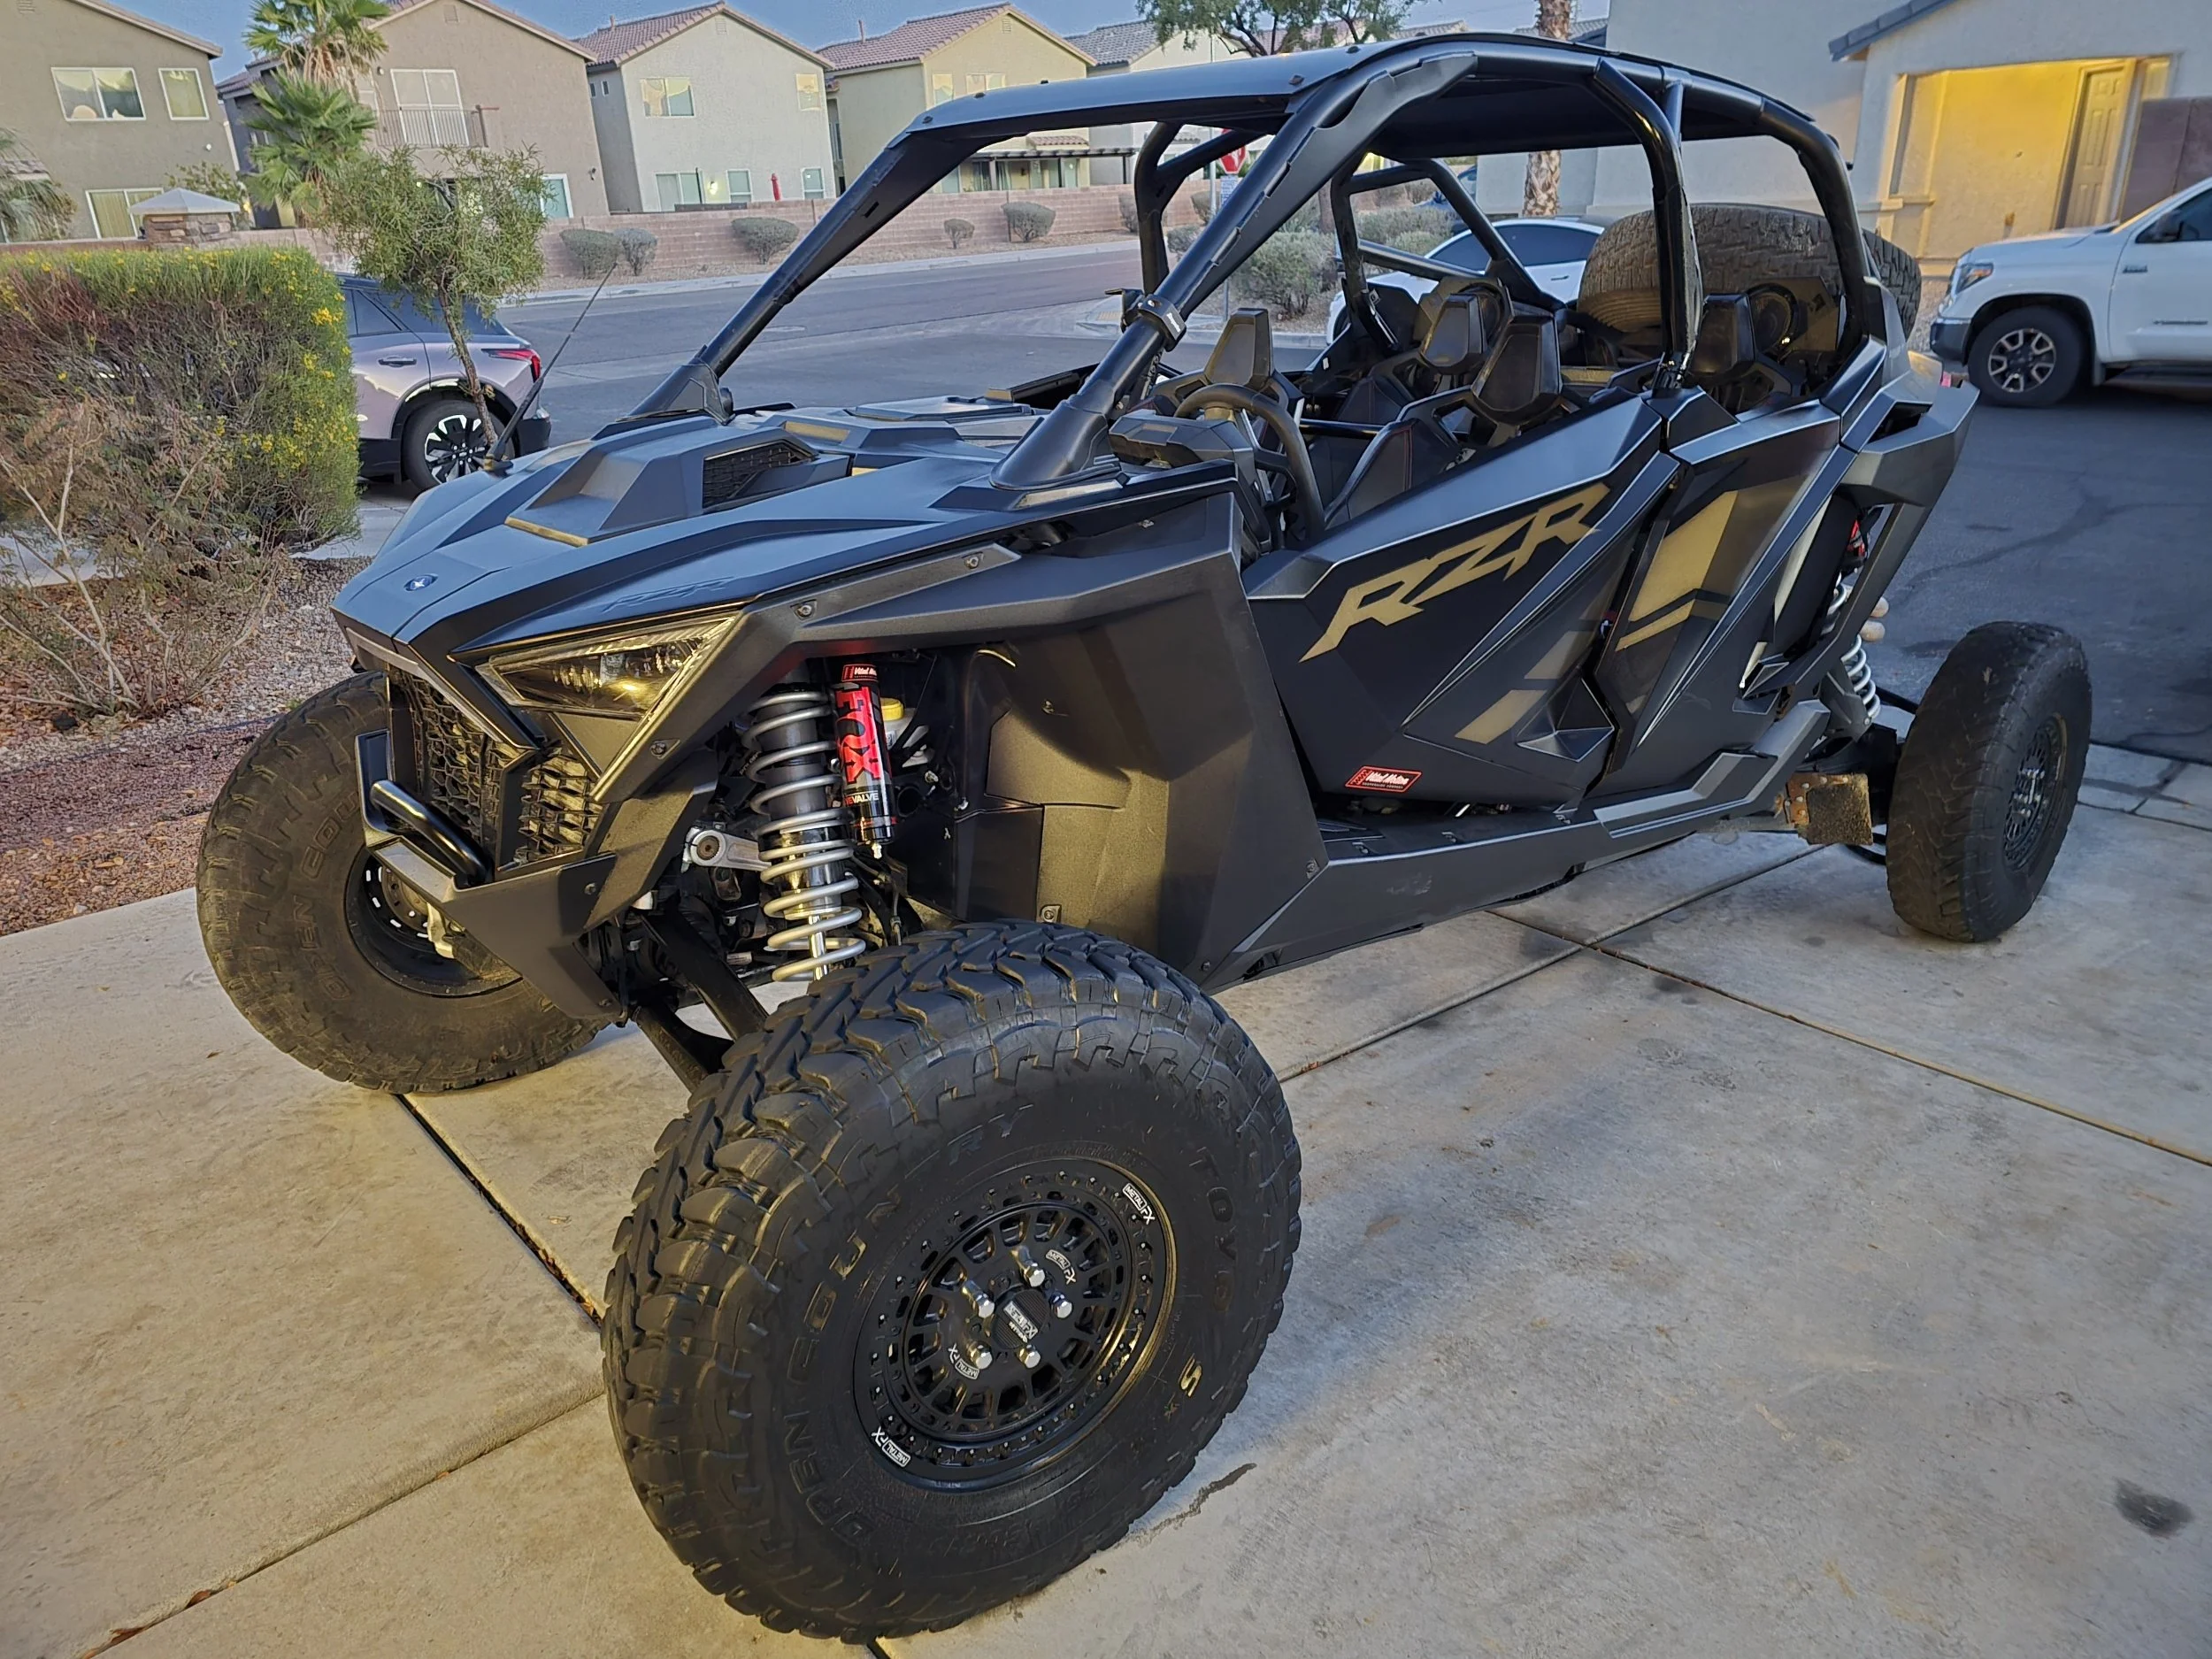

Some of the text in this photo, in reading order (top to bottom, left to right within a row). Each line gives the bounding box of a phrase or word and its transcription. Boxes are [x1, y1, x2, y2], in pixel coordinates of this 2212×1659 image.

[1298, 482, 1610, 664] RZR
[835, 686, 881, 784] FOX
[1124, 1184, 1156, 1225] METAL FX
[1189, 1147, 1237, 1315] TOYO
[1047, 1250, 1077, 1285] METAL FX
[948, 1342, 979, 1379] METAL FX
[871, 1425, 910, 1465] METAL FX
